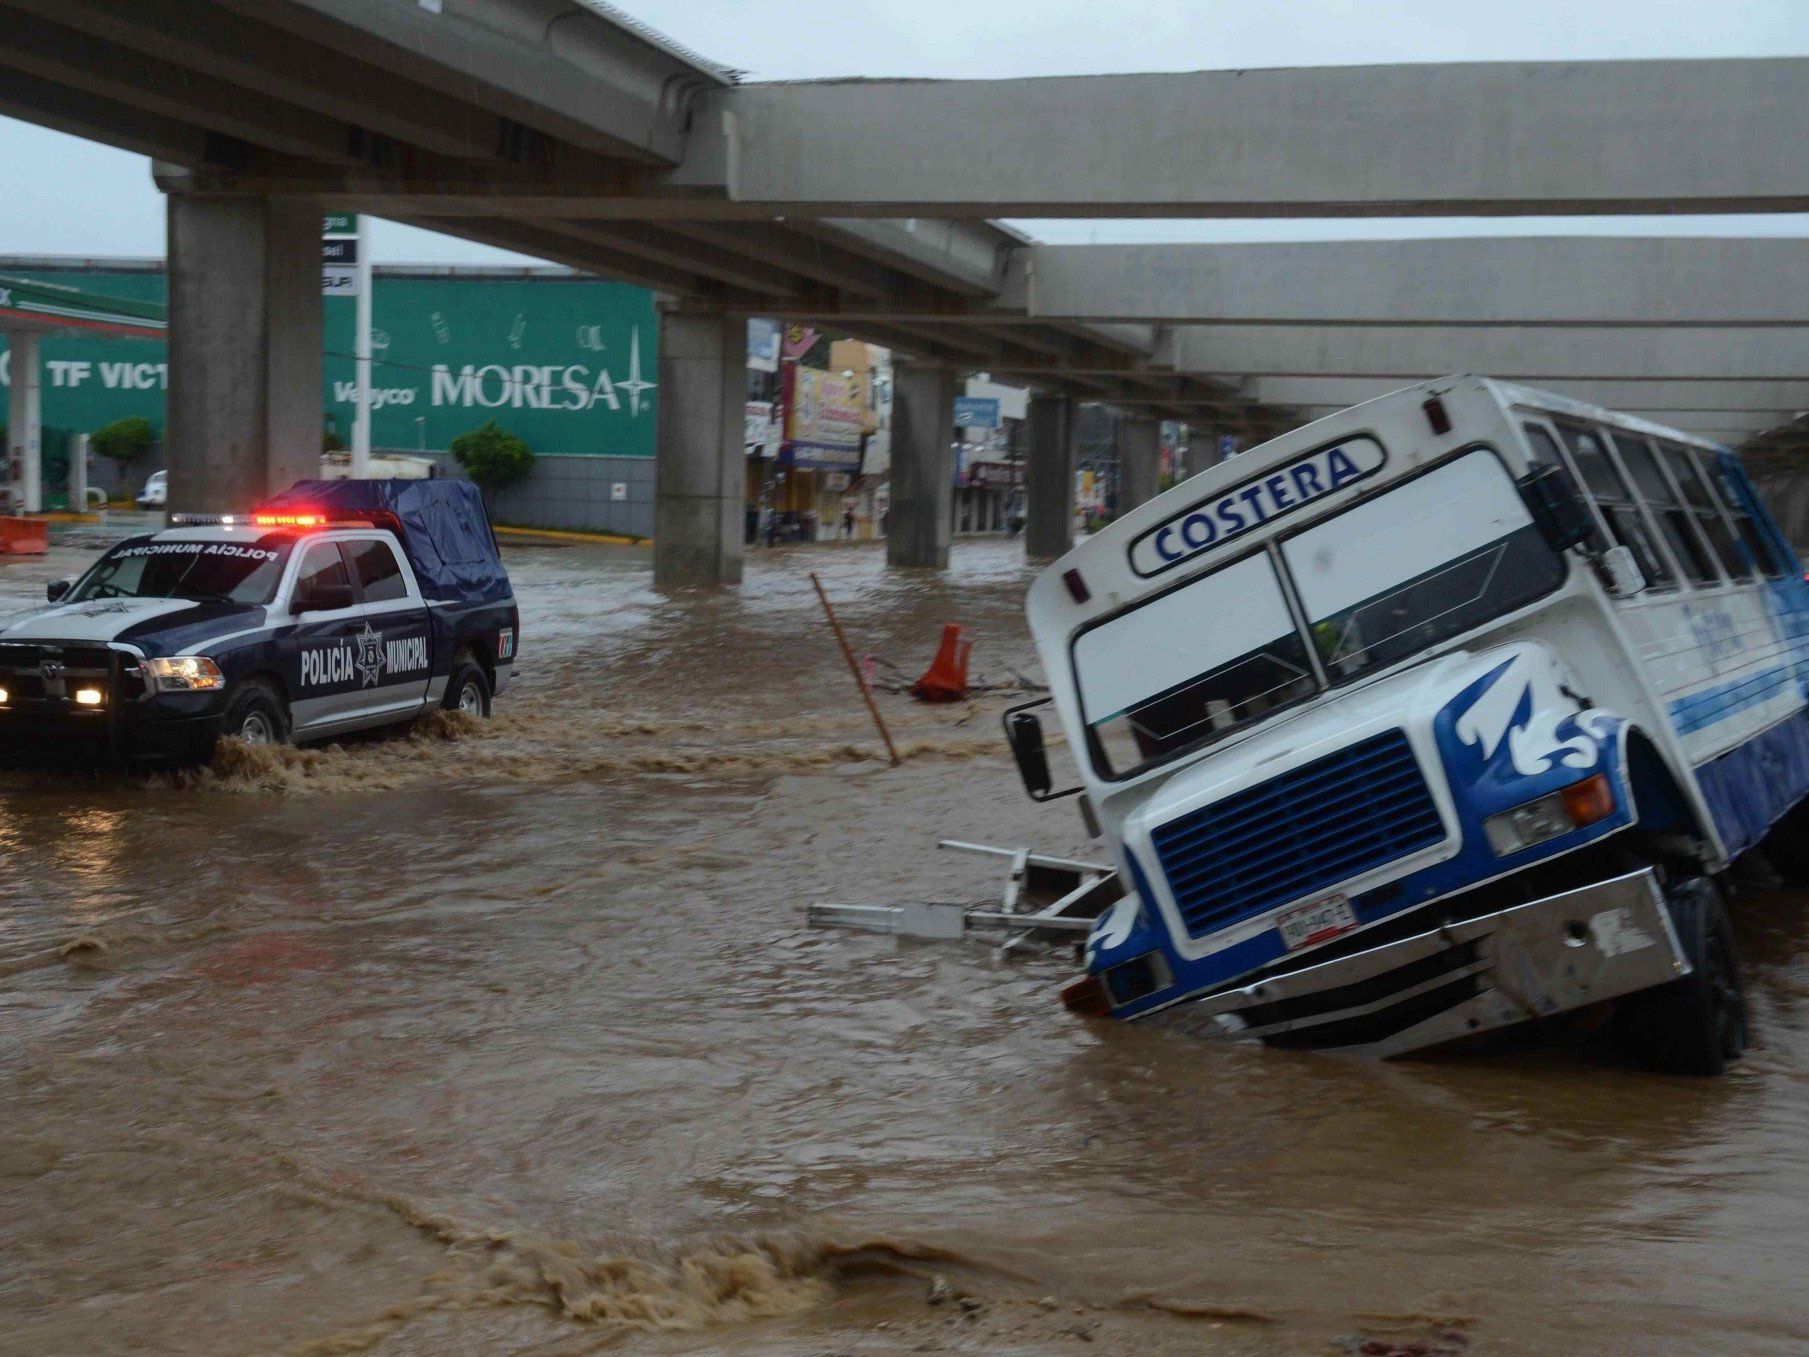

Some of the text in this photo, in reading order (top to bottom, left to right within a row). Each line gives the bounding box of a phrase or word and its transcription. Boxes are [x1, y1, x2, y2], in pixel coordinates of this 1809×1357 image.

[47, 361, 92, 387] TF
[333, 381, 416, 410] Veyco
[431, 363, 621, 411] MORESA
[1155, 447, 1361, 562] COSTERA
[300, 636, 429, 687] POLICÍA MUNICIPAL
